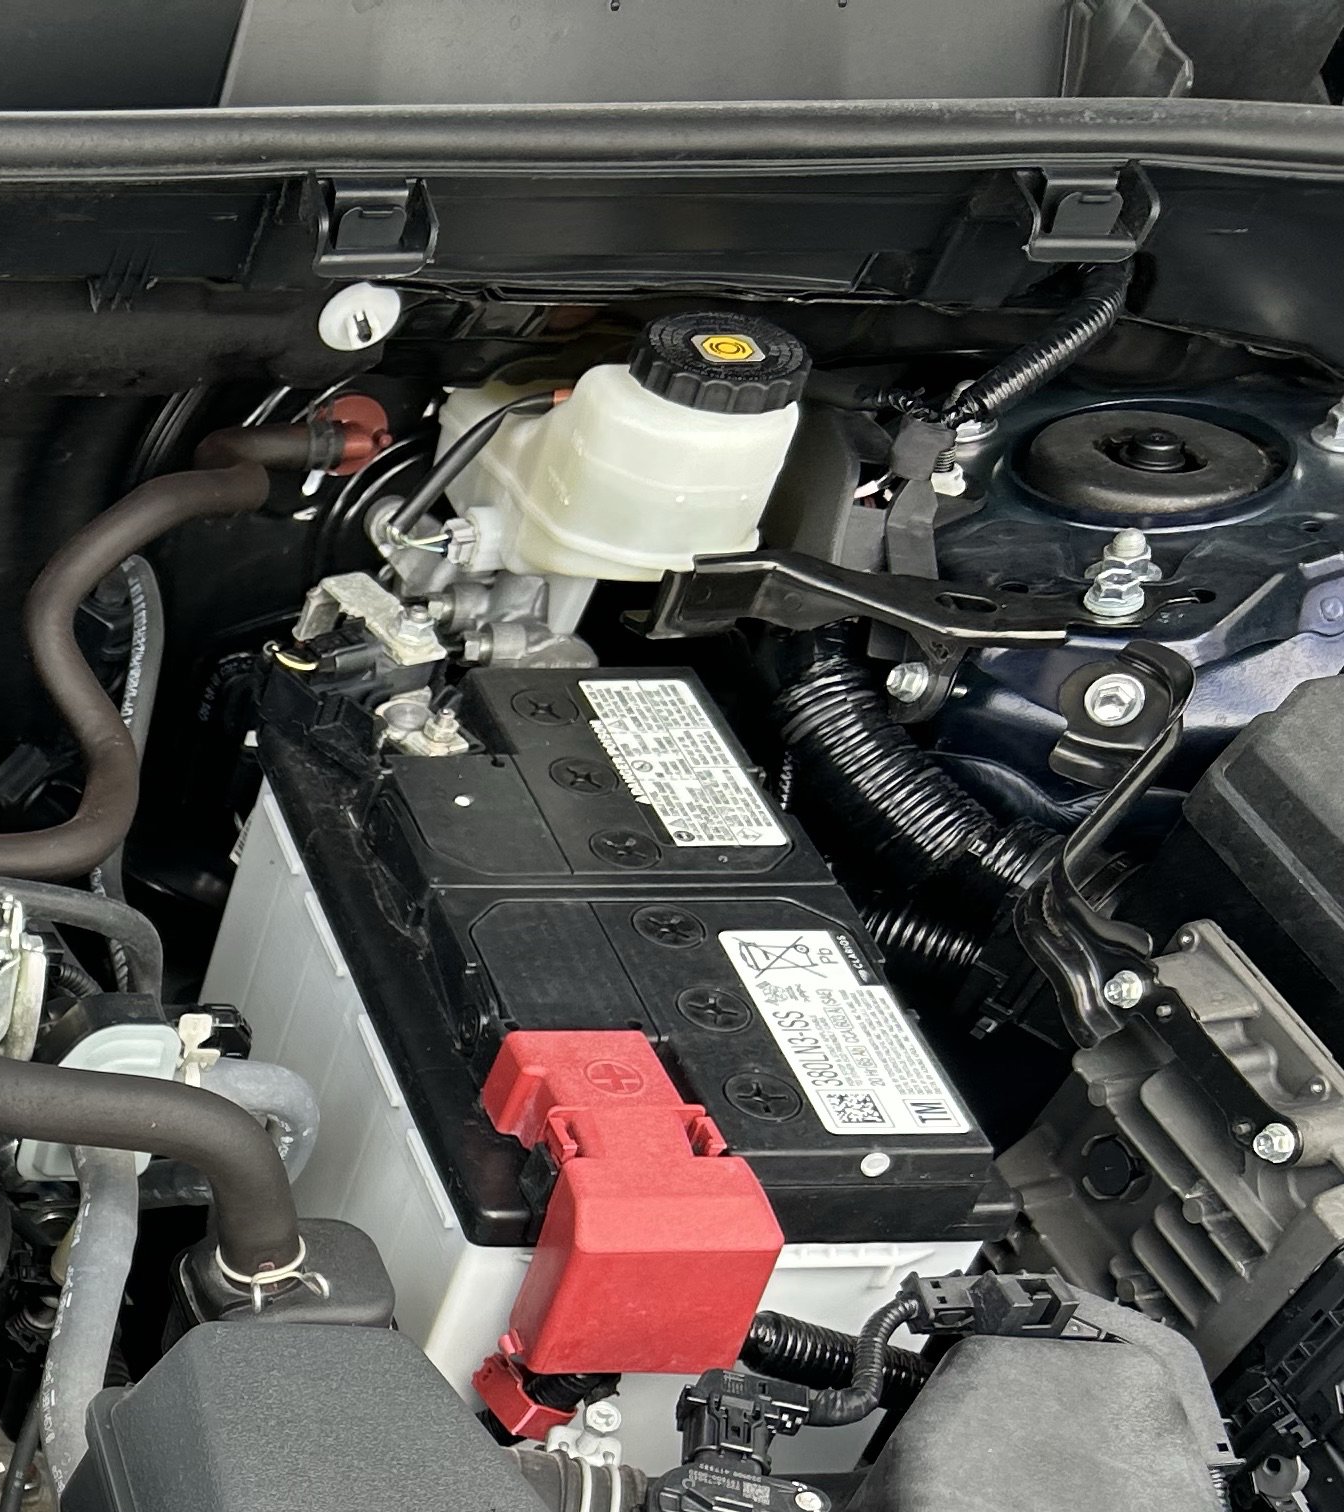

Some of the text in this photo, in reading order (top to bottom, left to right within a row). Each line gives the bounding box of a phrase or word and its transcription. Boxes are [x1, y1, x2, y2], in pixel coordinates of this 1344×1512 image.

[818, 947, 839, 963] Pb
[771, 1010, 844, 1087] 380LN3-ISS
[910, 1102, 952, 1123] TM
